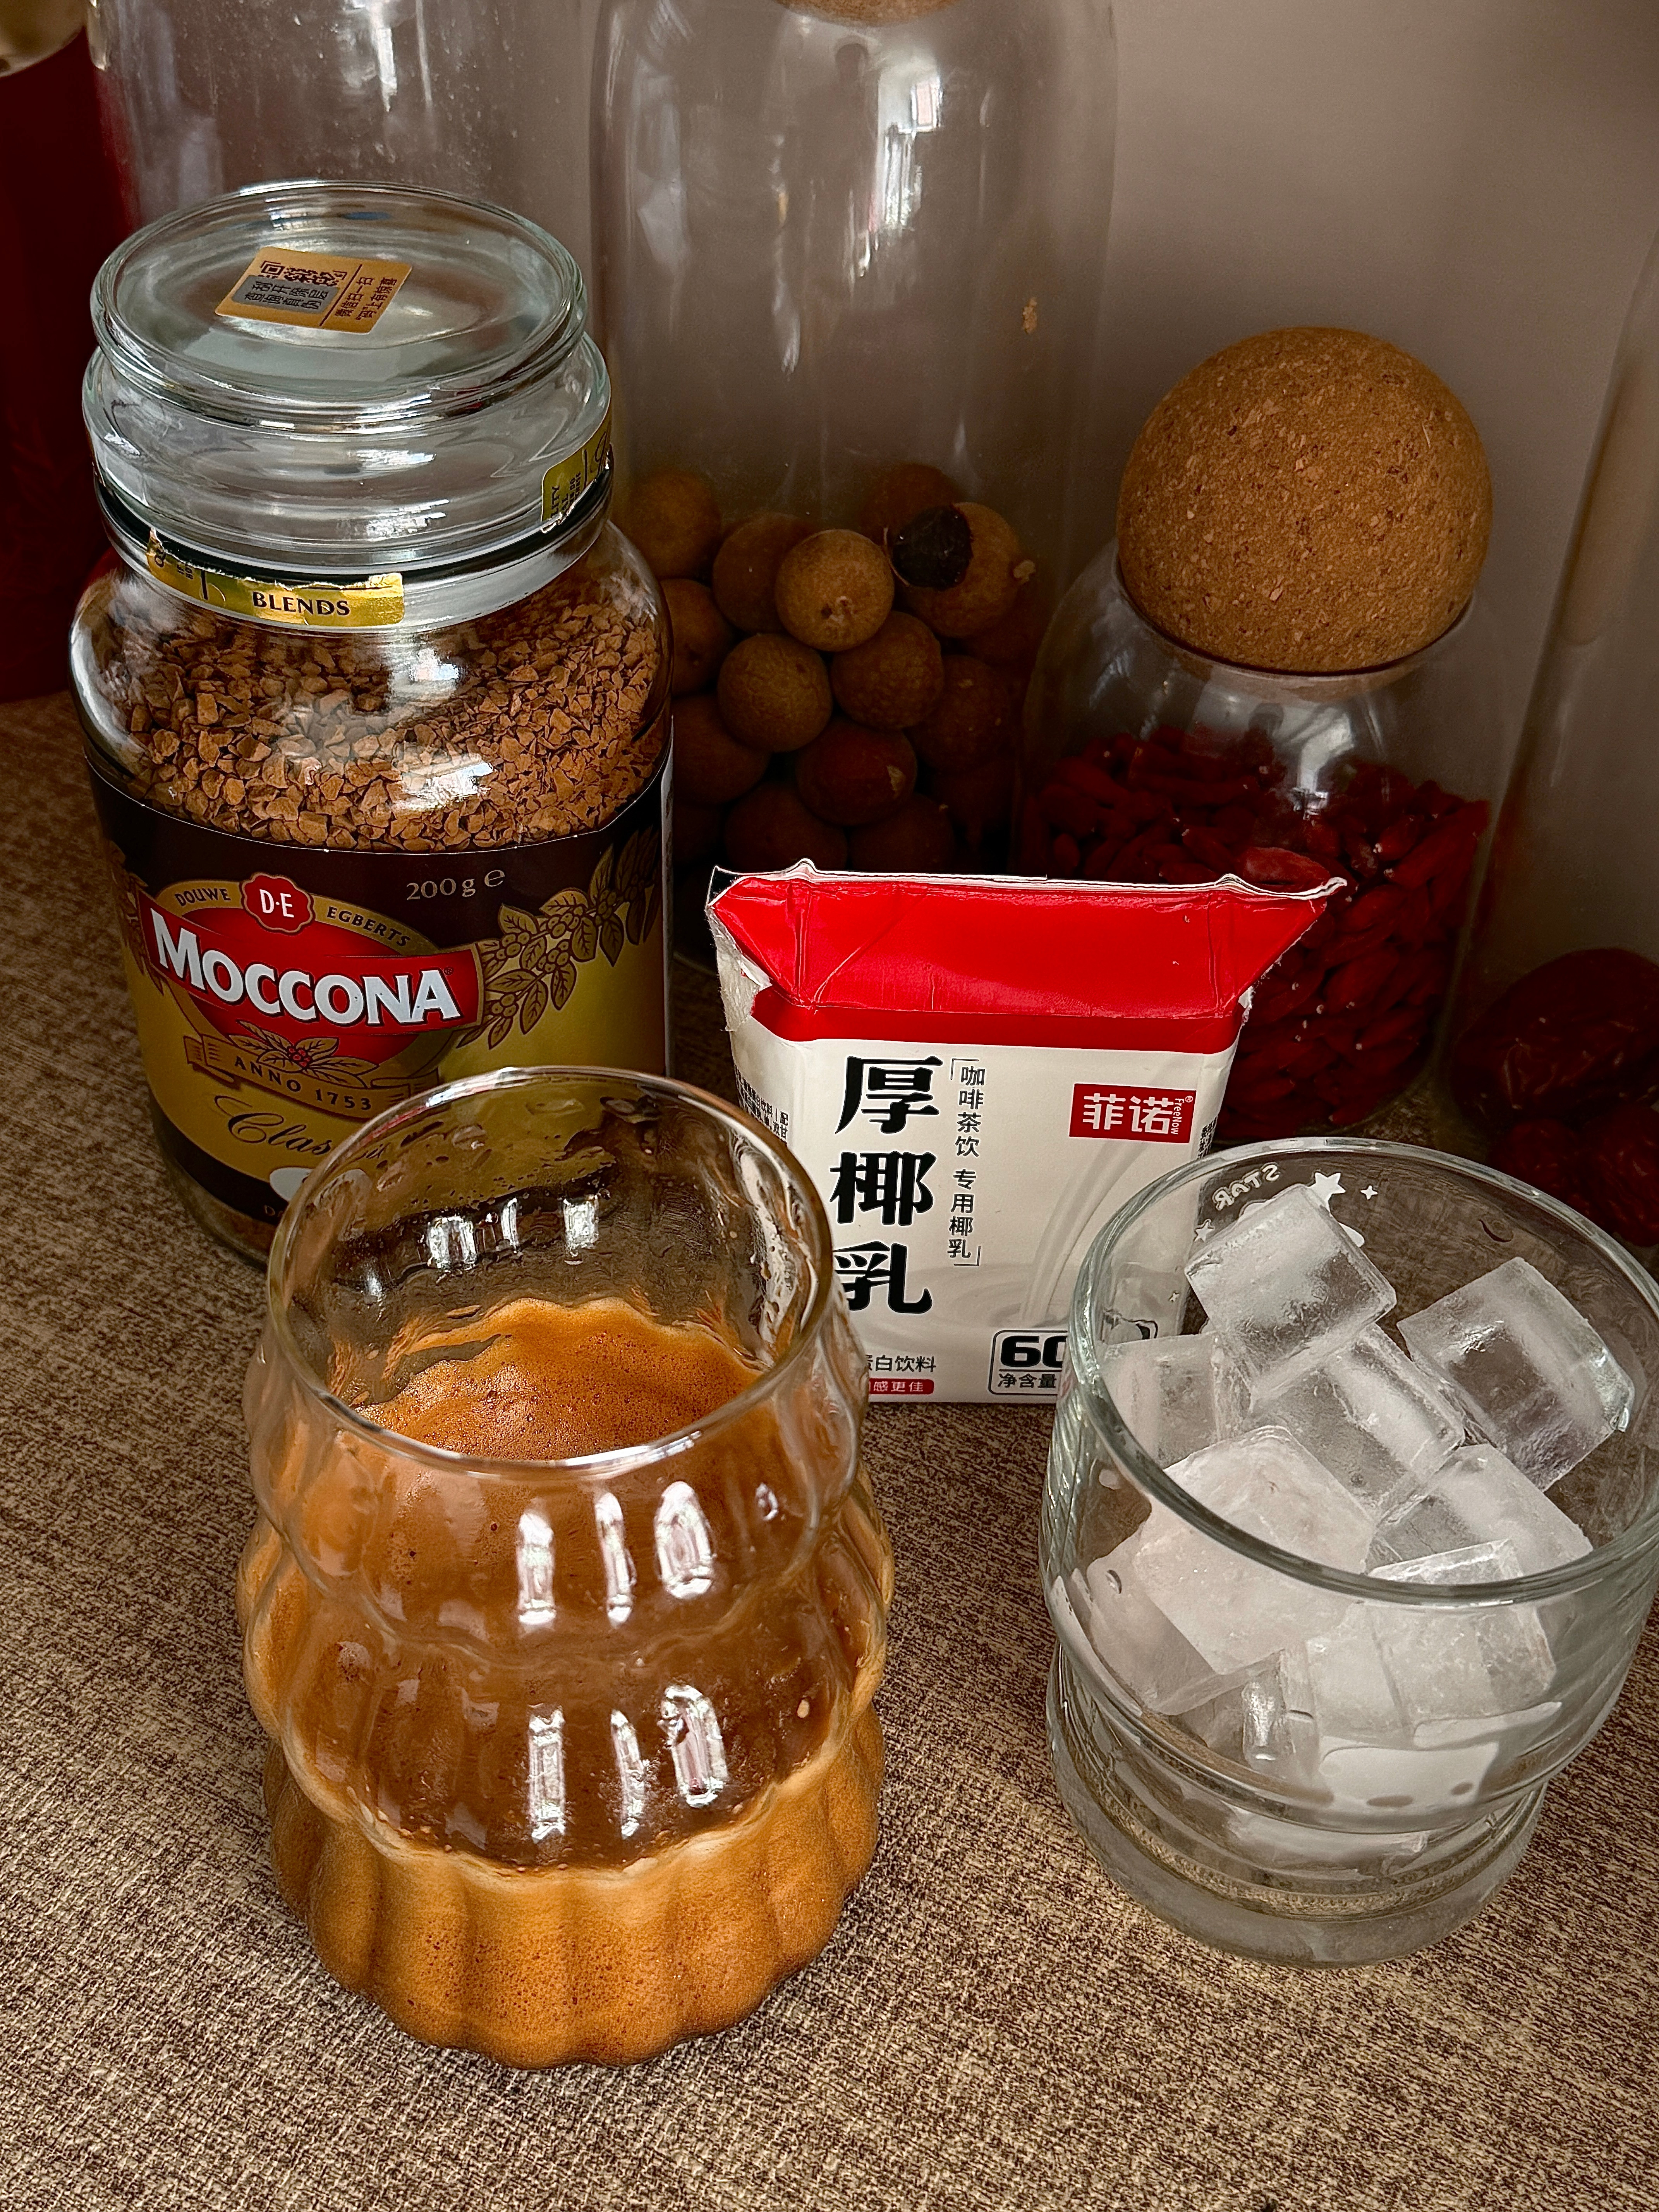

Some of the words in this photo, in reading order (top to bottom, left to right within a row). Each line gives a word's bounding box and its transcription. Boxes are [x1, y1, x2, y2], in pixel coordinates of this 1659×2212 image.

[245, 292, 322, 309] 查询真伪
[252, 281, 329, 300] 刮开涂层
[335, 277, 375, 317] 微信扫一扫
[550, 485, 560, 518] LITY
[252, 591, 350, 616] BLENDS
[175, 888, 231, 907] DOUWE
[326, 907, 411, 946] EGBERTS
[235, 1056, 301, 1092] ANNO
[315, 1089, 371, 1110] 1753
[214, 1095, 360, 1156] Clas
[1082, 1093, 1174, 1134] 菲诺
[830, 1056, 943, 1314] 厚椰乳
[869, 1381, 924, 1393] 感更佳
[998, 1374, 1056, 1389] 净含量
